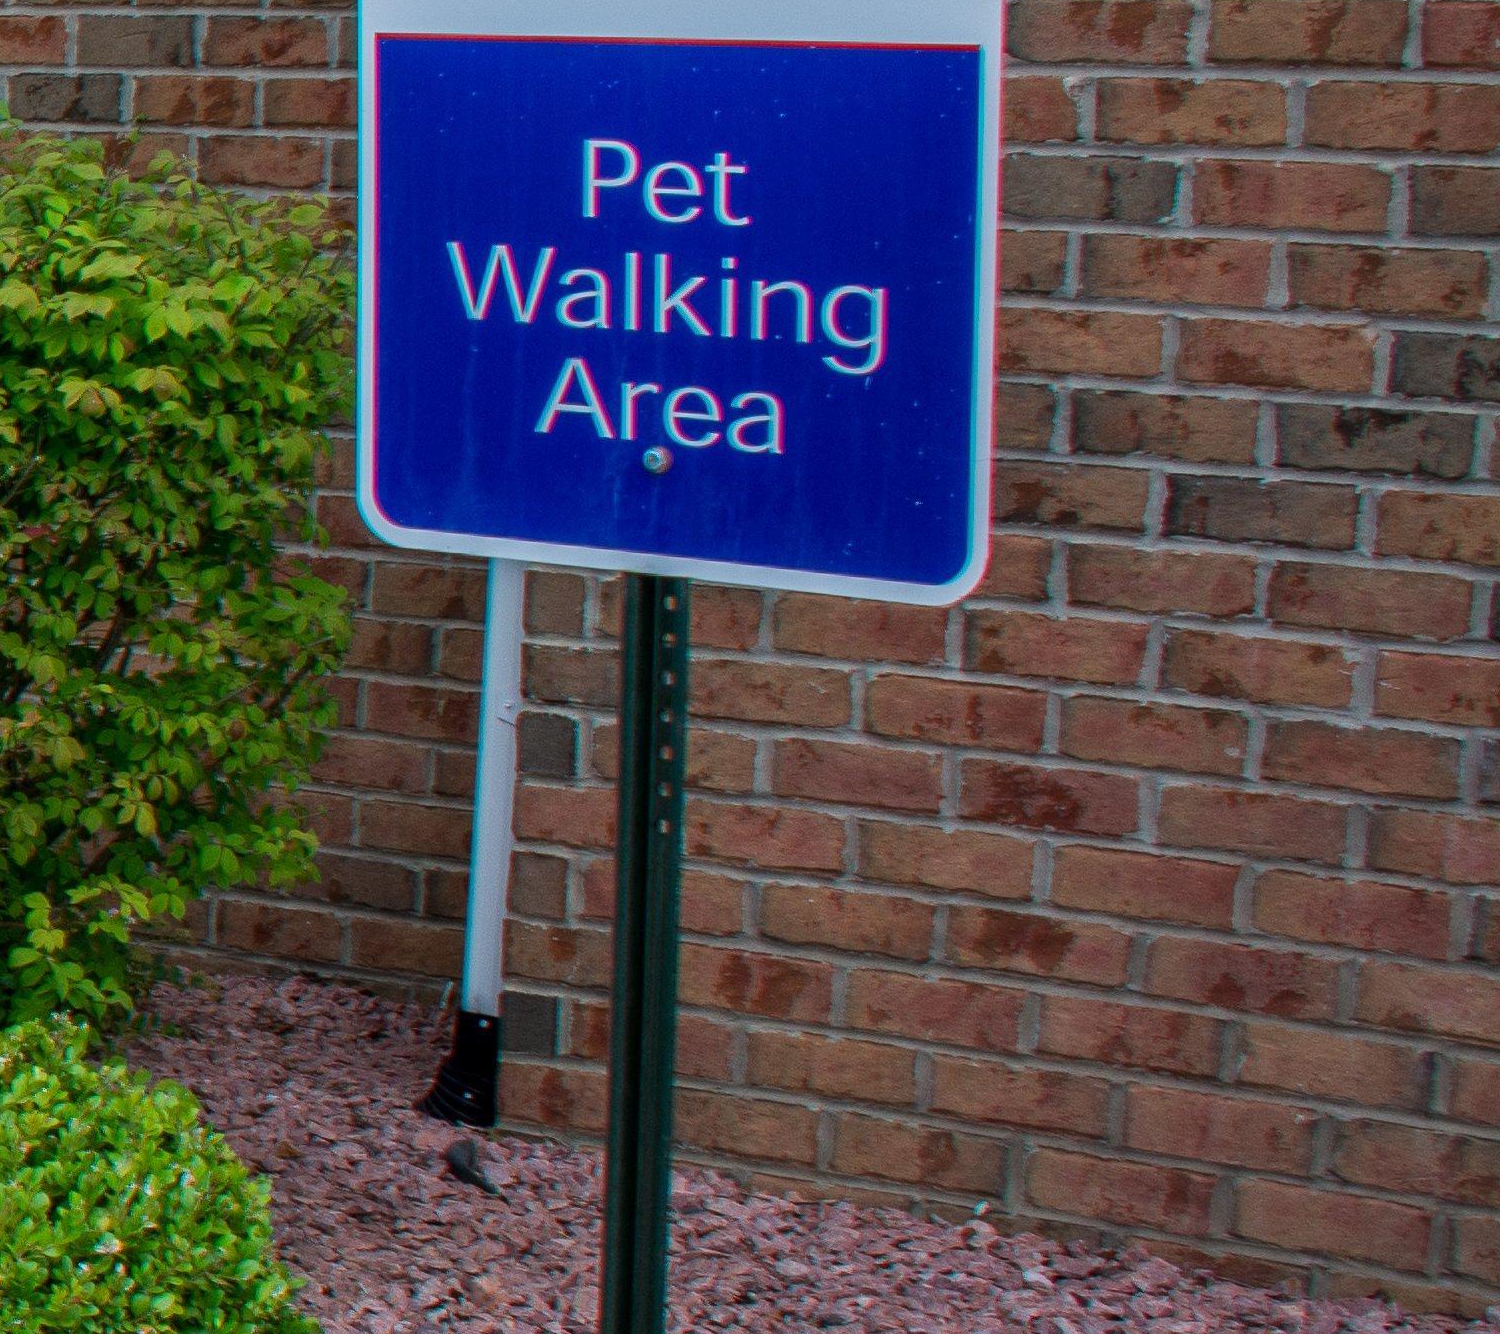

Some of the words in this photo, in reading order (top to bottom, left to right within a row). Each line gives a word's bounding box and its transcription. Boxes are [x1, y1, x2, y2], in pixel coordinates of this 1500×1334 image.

[582, 138, 752, 226] Pet
[446, 240, 889, 375] Walking
[533, 357, 787, 455] Area
